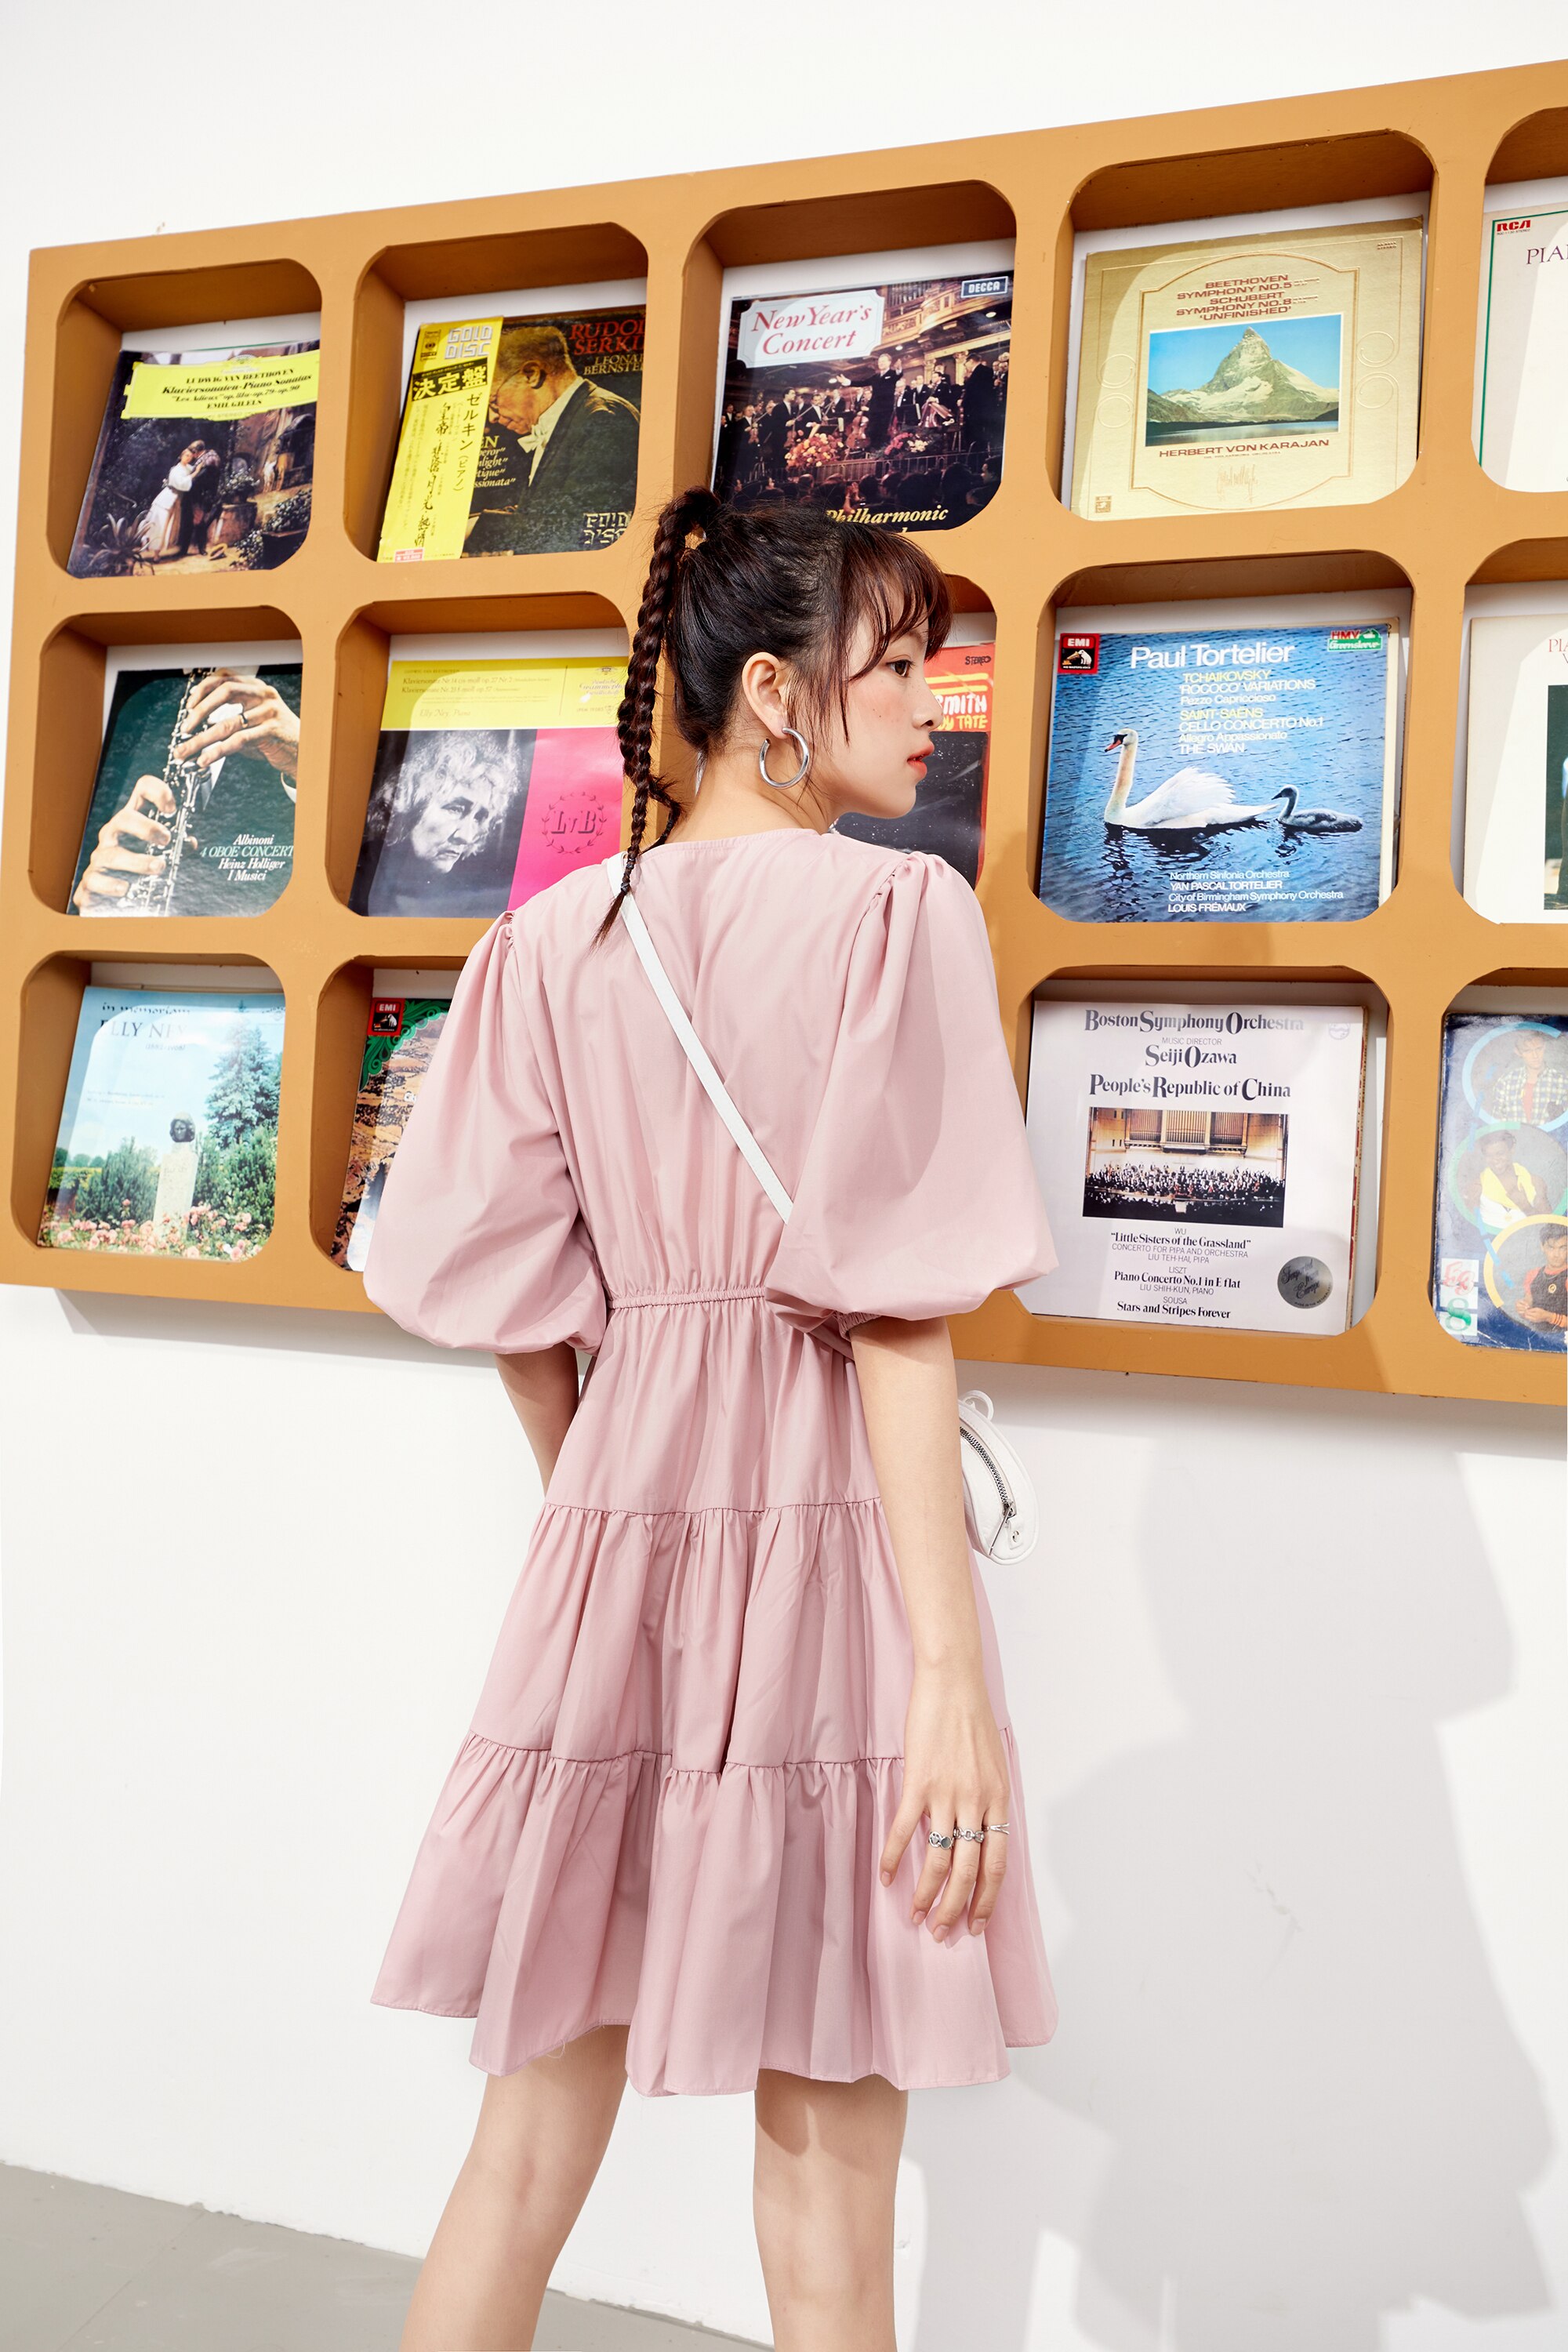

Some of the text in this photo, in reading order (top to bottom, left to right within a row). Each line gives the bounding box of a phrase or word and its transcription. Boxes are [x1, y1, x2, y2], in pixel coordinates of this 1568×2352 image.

[1497, 220, 1531, 232] RCA
[1526, 245, 1568, 265] PIA
[968, 281, 1001, 293] DECCA
[1205, 274, 1289, 289] BEETHOVEN
[1177, 285, 1256, 299] SYMPHONY
[1210, 291, 1285, 305] SCHUBERT
[1176, 302, 1255, 316] SYMPHONY
[751, 304, 872, 332] New Year's
[448, 325, 492, 343] GOLD
[762, 330, 858, 355] Concert
[445, 342, 490, 359] DISC
[413, 365, 487, 401] 決定盤
[1159, 439, 1330, 458] HERBERT VON KARAJAN
[826, 504, 949, 524] Philharmonic
[1330, 630, 1360, 640] HMV
[1067, 638, 1090, 647] EMI
[965, 655, 991, 666] STEREO
[1131, 641, 1295, 669] Paul Tortelier
[1182, 670, 1271, 683] TCHAIKOVSKY
[1243, 679, 1316, 691] VARIATIONS
[1180, 693, 1276, 706] Pezzo Capriccioso
[956, 714, 988, 729] TATE
[1178, 720, 1221, 732] CELLO
[1222, 717, 1298, 731] CONCERTO
[1178, 730, 1288, 744] Allegro Appassionato
[1179, 742, 1245, 754] THE SWAN
[233, 833, 275, 846] Albinoni
[200, 845, 294, 858] 4 OBOE CONCERT
[218, 857, 285, 871] Heinz Holliger
[227, 869, 267, 881] I Musici
[1170, 869, 1290, 880] Northern Sinfonia Orchestra
[1171, 880, 1283, 891] YAN PASCAL TORTELIER
[1197, 892, 1248, 902] Birmingham
[1249, 891, 1298, 902] Symphony
[1298, 891, 1344, 900] Orchestra
[1168, 904, 1198, 913] LOUIS
[1084, 1009, 1304, 1035] Boston Symphony Orchestra
[1161, 1036, 1222, 1046] MUSIC DIRECTOR
[1145, 1044, 1236, 1068] Seiji Ozawa
[1089, 1073, 1291, 1101] People's Republic of China
[1138, 1233, 1171, 1245] Sisters
[1171, 1236, 1181, 1245] of
[1182, 1236, 1198, 1246] the
[1112, 1243, 1151, 1252] CONCERTO
[1153, 1245, 1167, 1254] FOR
[1186, 1247, 1203, 1256] AND
[1204, 1249, 1249, 1258] ORCHESTRA
[1148, 1253, 1160, 1261] LIU
[1114, 1271, 1140, 1282] Piano
[1142, 1272, 1182, 1284] Concerto
[1204, 1277, 1214, 1287] in
[1216, 1277, 1222, 1287] E
[1224, 1278, 1241, 1289] flat
[1192, 1287, 1214, 1296] PIANO
[1163, 1296, 1188, 1305] SOUSA
[1117, 1301, 1231, 1319] Stars and Stripes Forever
